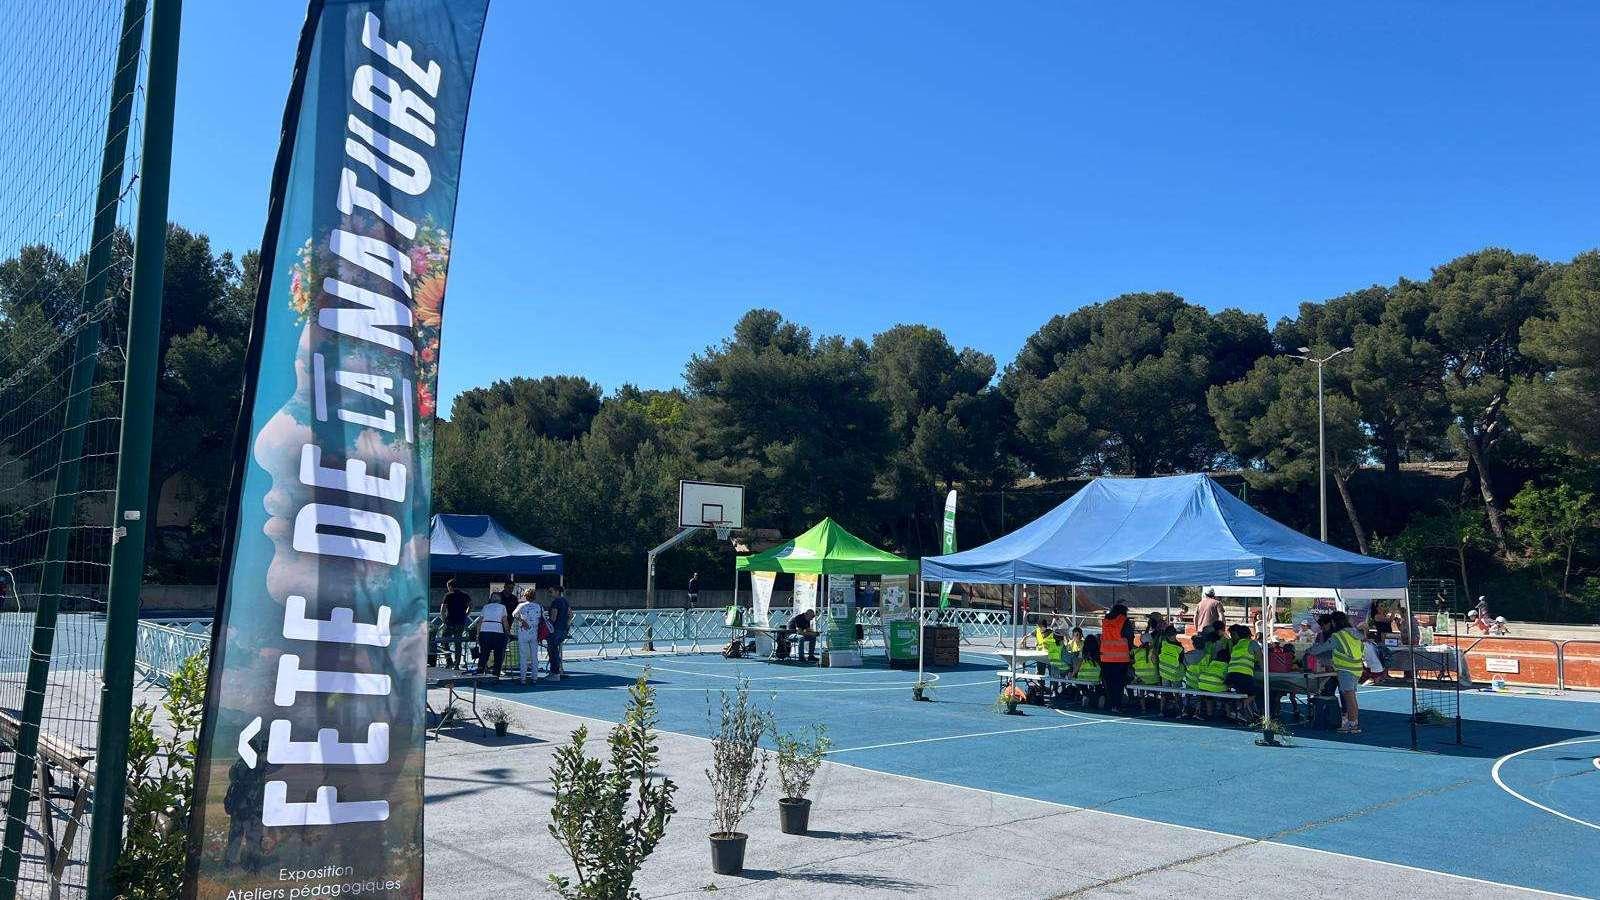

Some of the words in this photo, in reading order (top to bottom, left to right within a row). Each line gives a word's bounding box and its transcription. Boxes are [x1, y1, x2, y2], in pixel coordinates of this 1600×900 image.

[318, 11, 441, 355] NATURE
[337, 376, 396, 433] LA
[293, 443, 407, 566] DE
[238, 596, 391, 827] FÊTE
[226, 886, 286, 900] Ateliers
[289, 878, 402, 900] pédagogiques
[279, 865, 353, 883] Exposition
